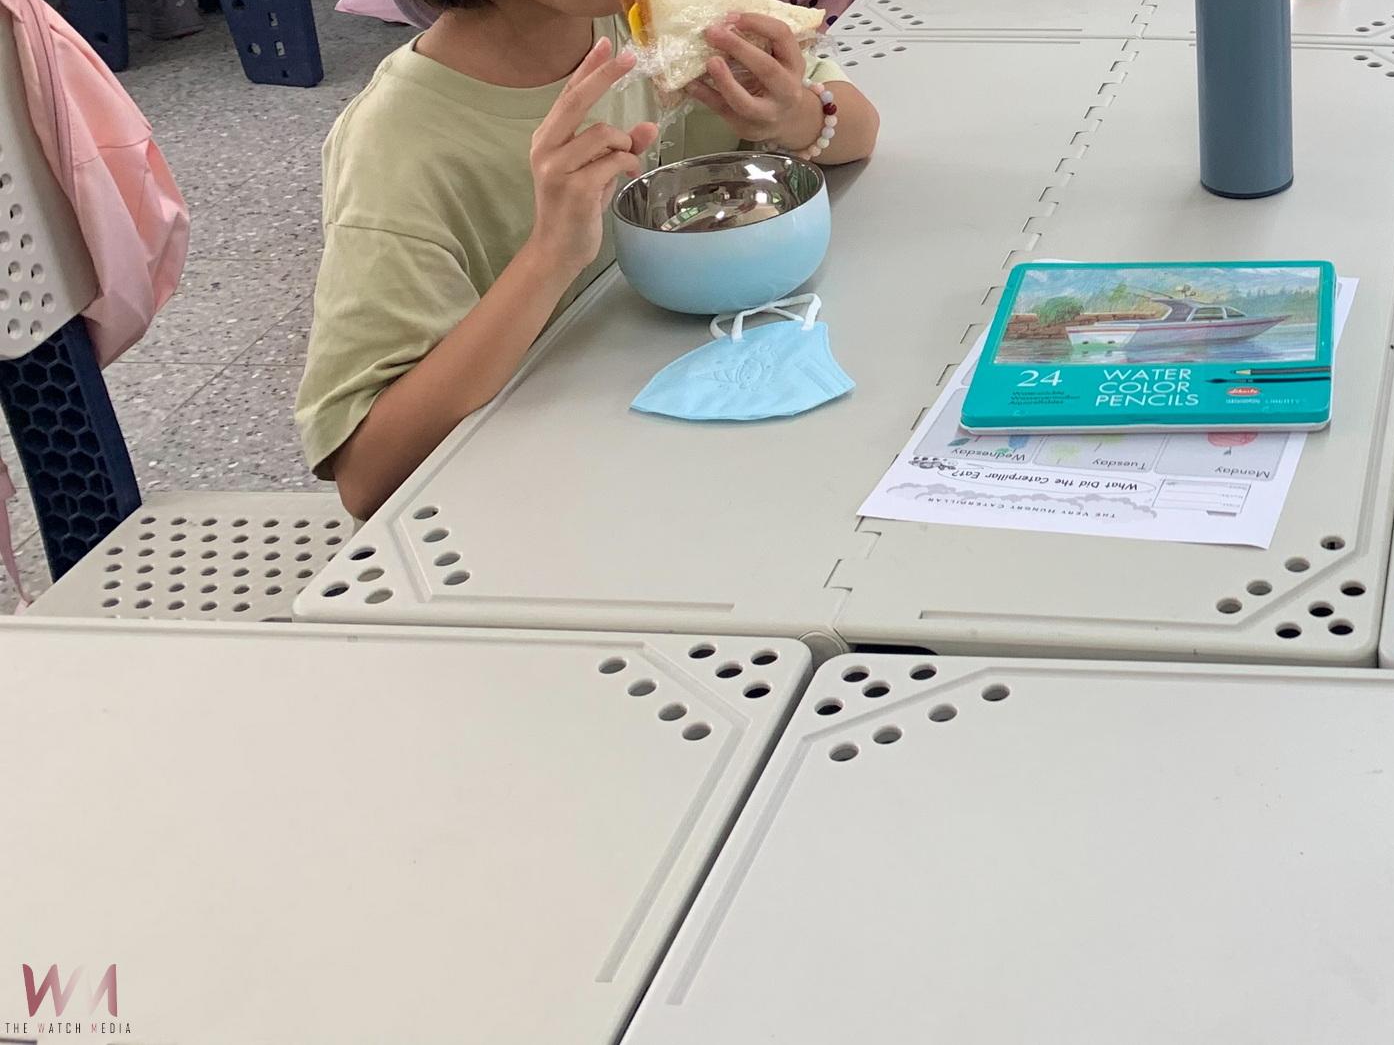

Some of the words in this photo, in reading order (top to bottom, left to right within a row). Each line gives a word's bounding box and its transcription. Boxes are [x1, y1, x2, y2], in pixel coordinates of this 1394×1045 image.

[1016, 369, 1063, 387] 24
[1103, 368, 1192, 381] WATER
[1098, 381, 1190, 394] COLOR
[1095, 394, 1200, 407] PENCILS
[950, 446, 1026, 463] Wednesday
[1092, 456, 1146, 471] Tuesday
[950, 465, 981, 480] Eat?
[984, 470, 1048, 486] Caterpillar
[1215, 464, 1271, 479] Monday
[1054, 475, 1074, 487] the
[1075, 479, 1100, 489] Did
[1105, 480, 1139, 492] What
